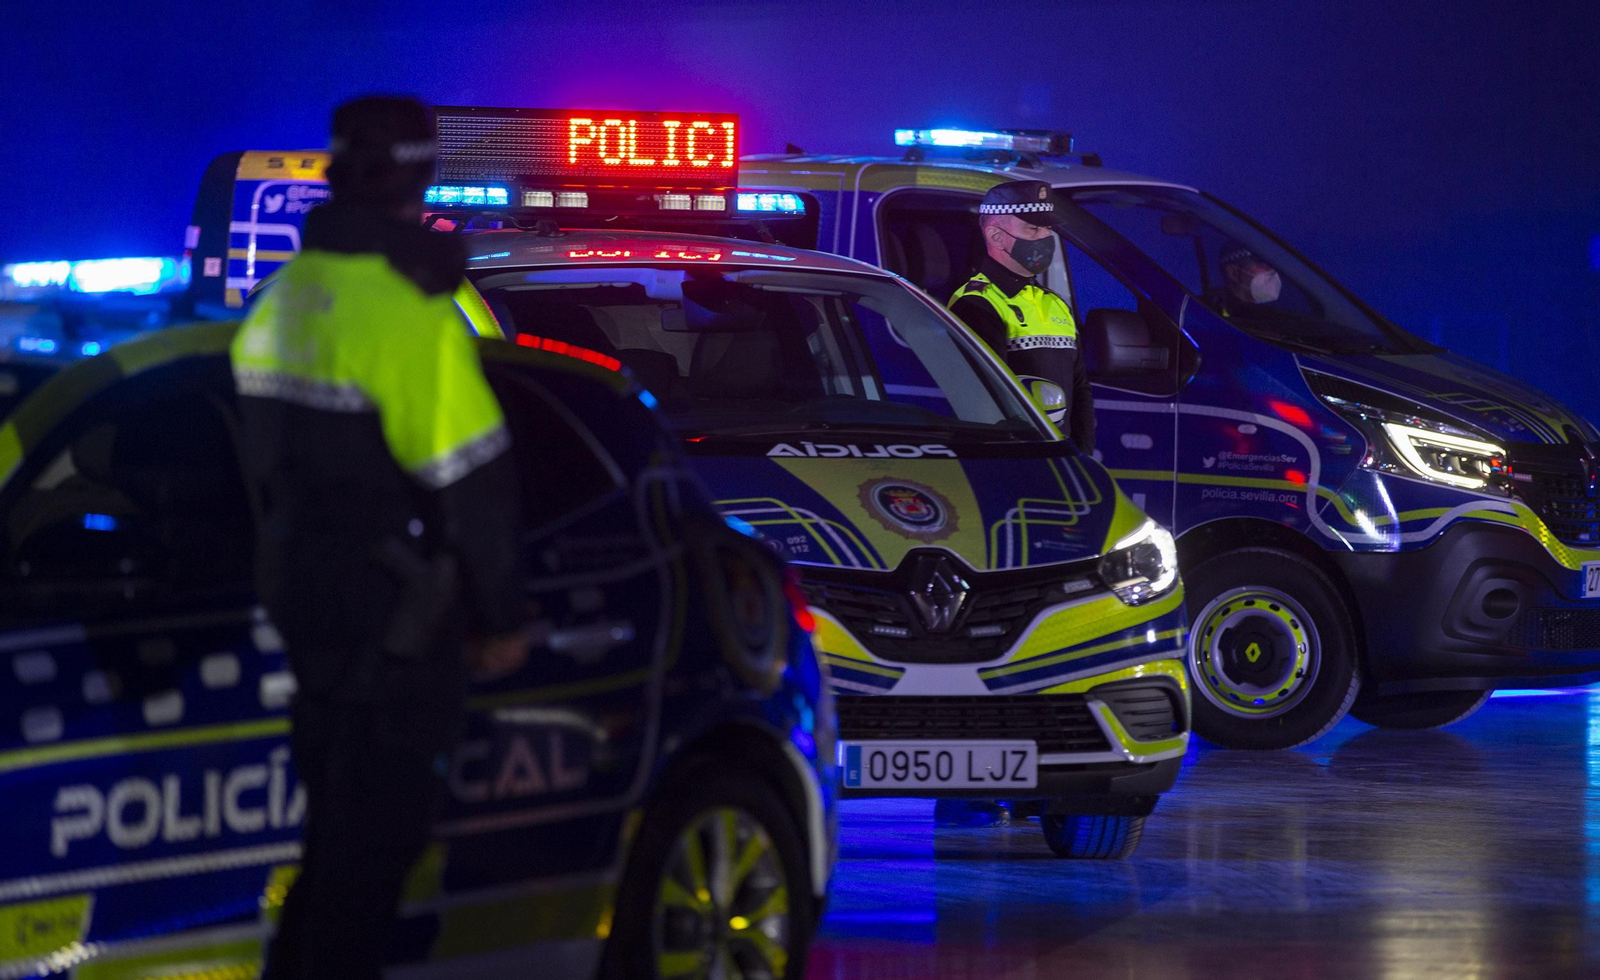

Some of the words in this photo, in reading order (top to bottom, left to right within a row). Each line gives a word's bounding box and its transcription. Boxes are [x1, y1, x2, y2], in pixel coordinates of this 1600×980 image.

[786, 535, 808, 545] 092
[789, 544, 811, 554] 112
[869, 751, 953, 781] 0950
[968, 751, 1027, 781] LJZ
